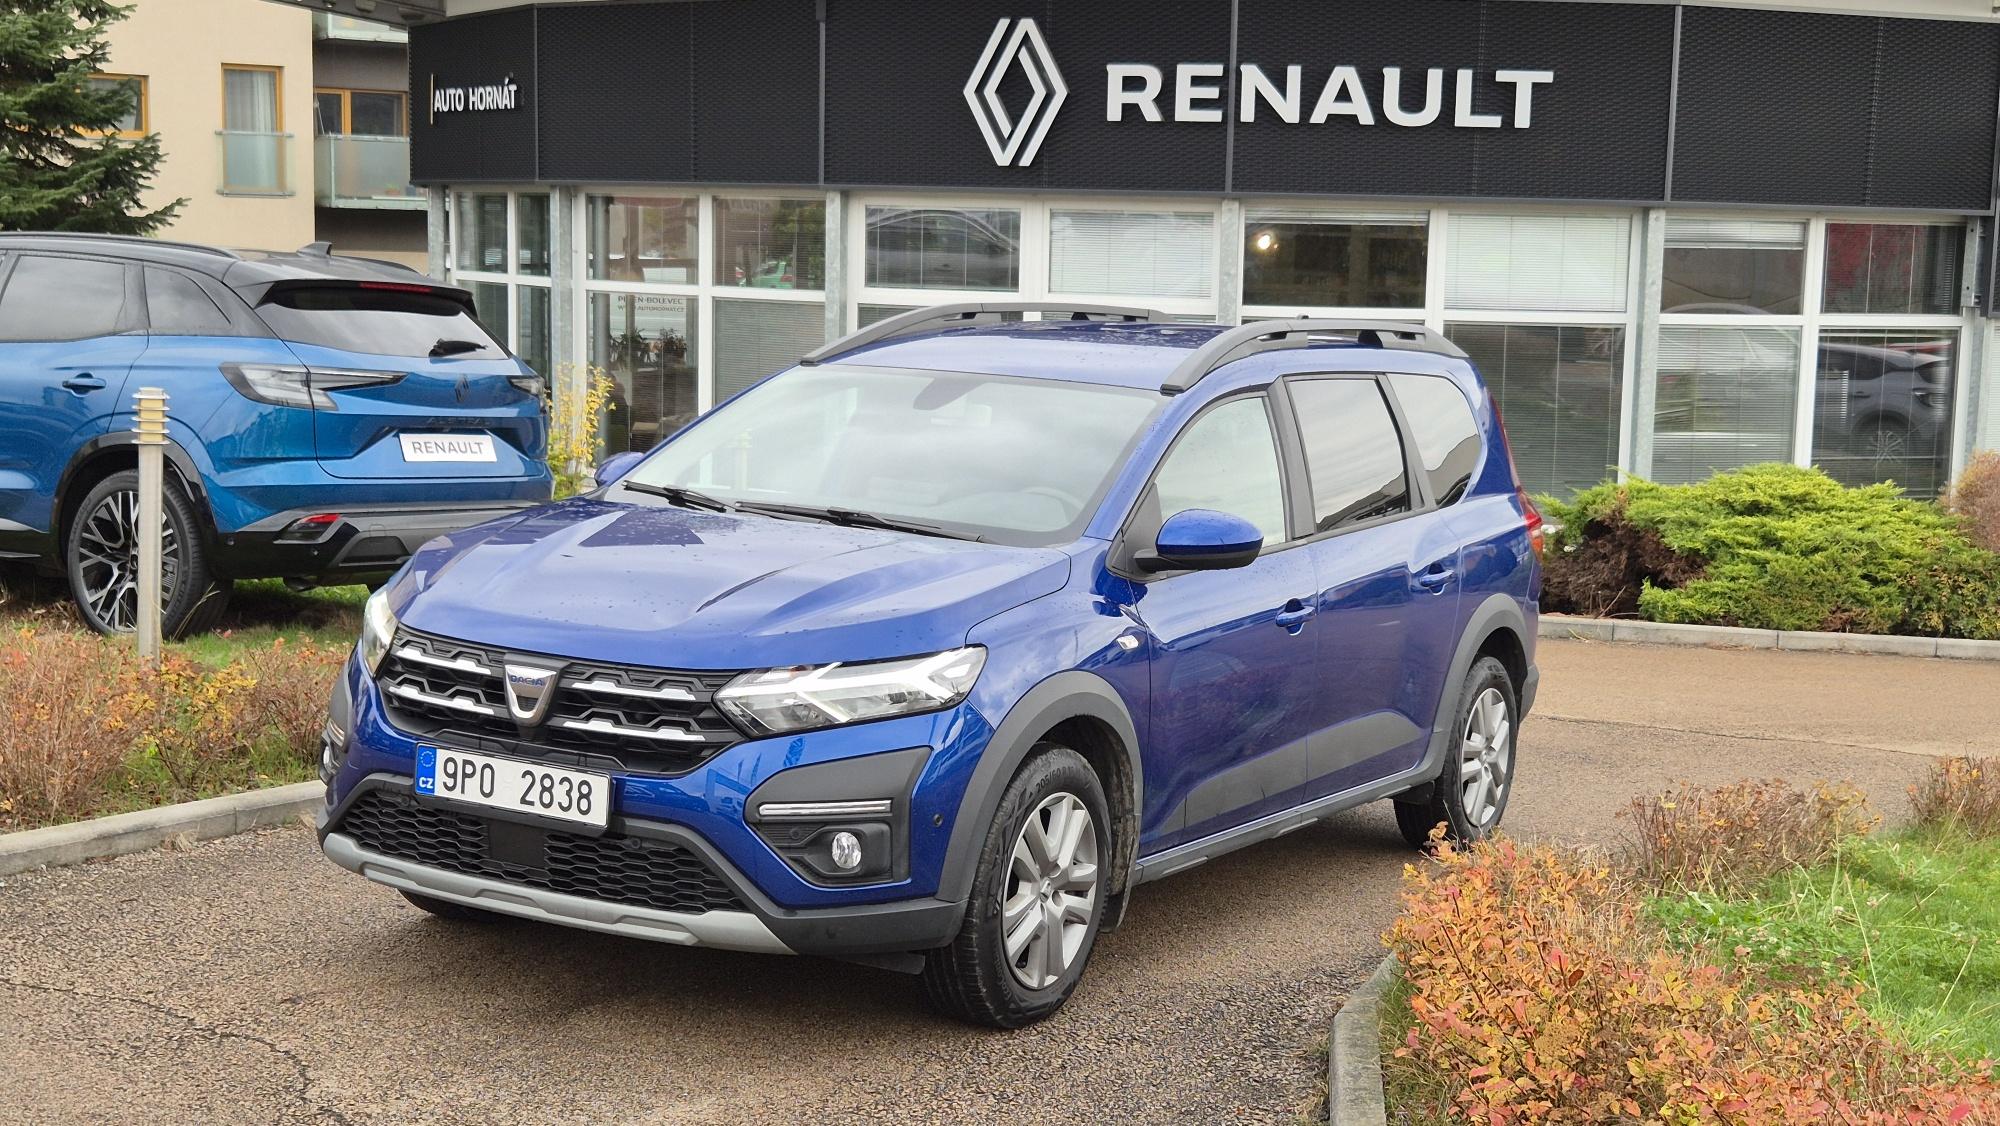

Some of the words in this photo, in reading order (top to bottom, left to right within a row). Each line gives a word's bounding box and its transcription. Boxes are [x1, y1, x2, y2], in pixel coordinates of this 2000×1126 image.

[434, 87, 464, 112] AUTO
[468, 76, 517, 111] HORNÁT
[1106, 63, 1554, 129] RENAULT
[411, 440, 484, 455] RENAULT
[510, 675, 544, 687] DACIA
[419, 777, 434, 789] CZ
[442, 757, 495, 799] 9P0
[519, 769, 593, 816] 2838
